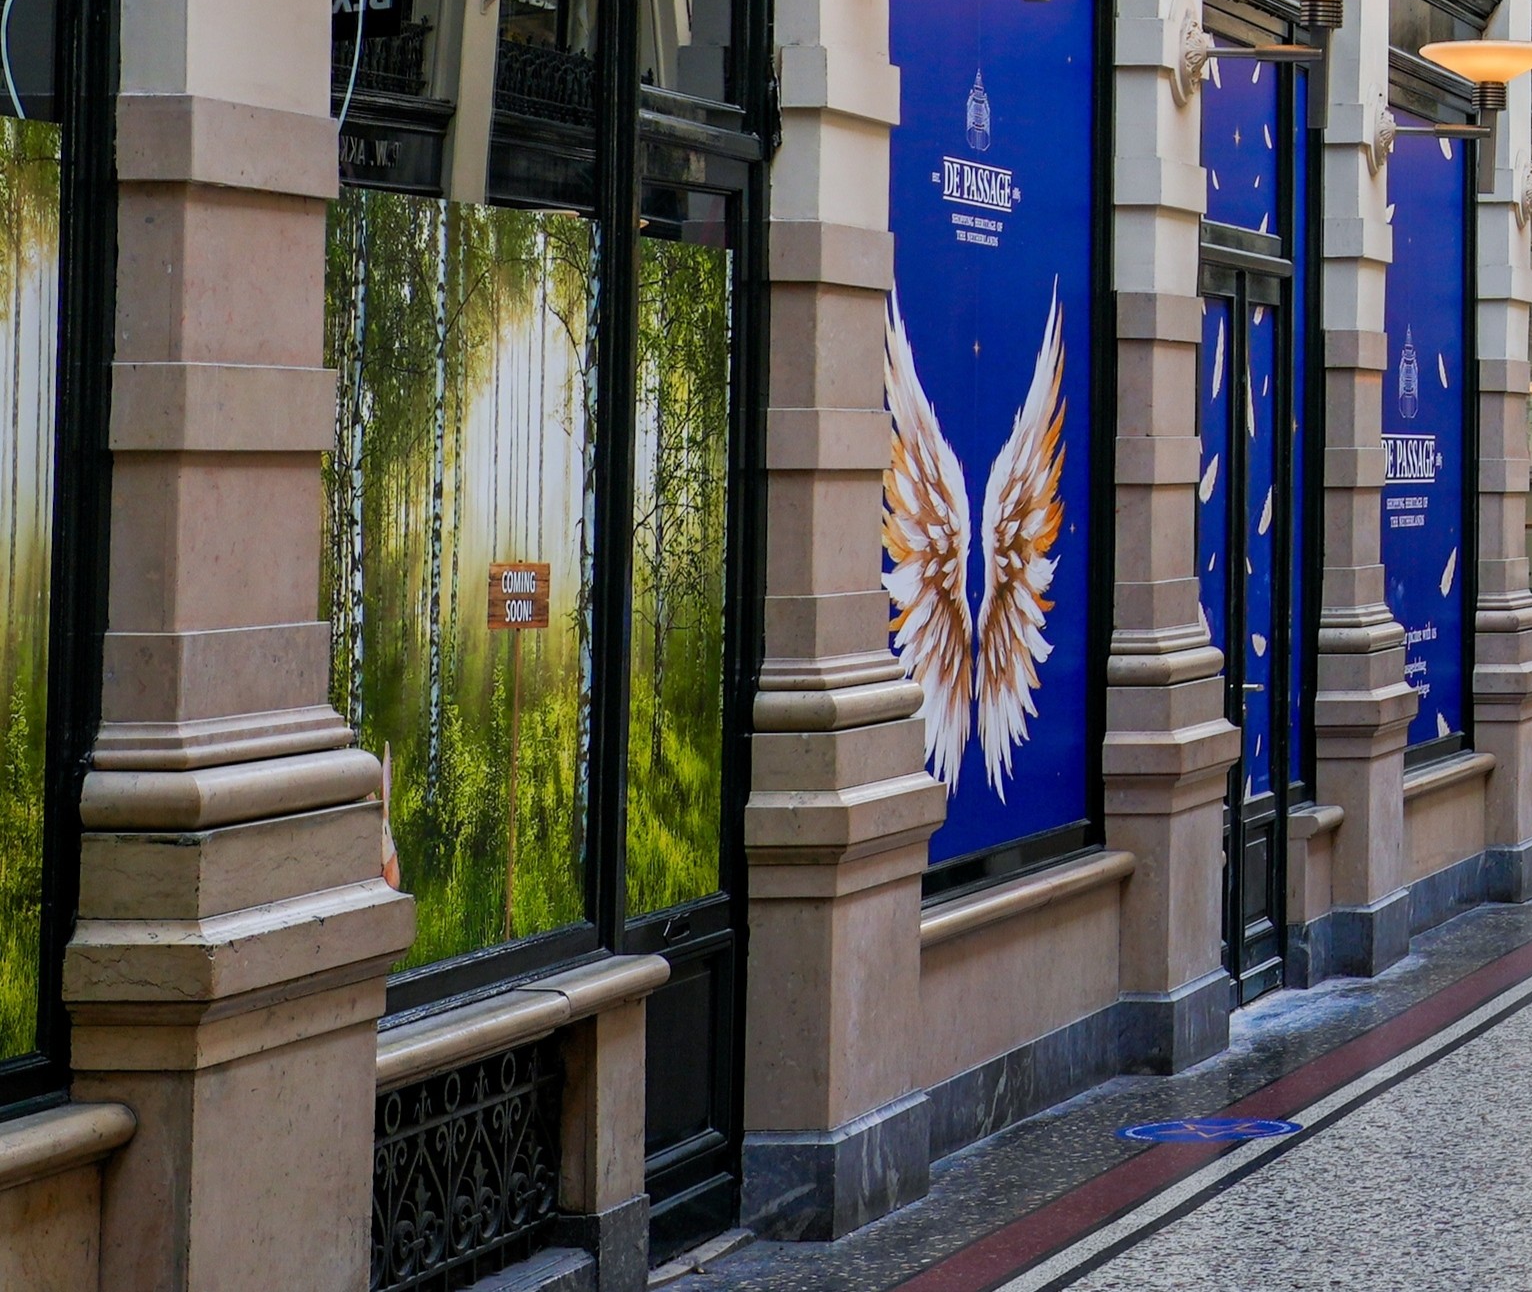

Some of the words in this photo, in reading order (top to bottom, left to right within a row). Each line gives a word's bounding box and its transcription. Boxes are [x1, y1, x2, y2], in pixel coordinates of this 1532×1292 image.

[943, 161, 961, 197] DE
[963, 165, 1012, 208] PASSAGE
[1396, 439, 1435, 478] PASSAGE
[502, 571, 536, 593] COMING
[505, 599, 533, 622] SOON!
[1422, 621, 1431, 640] with
